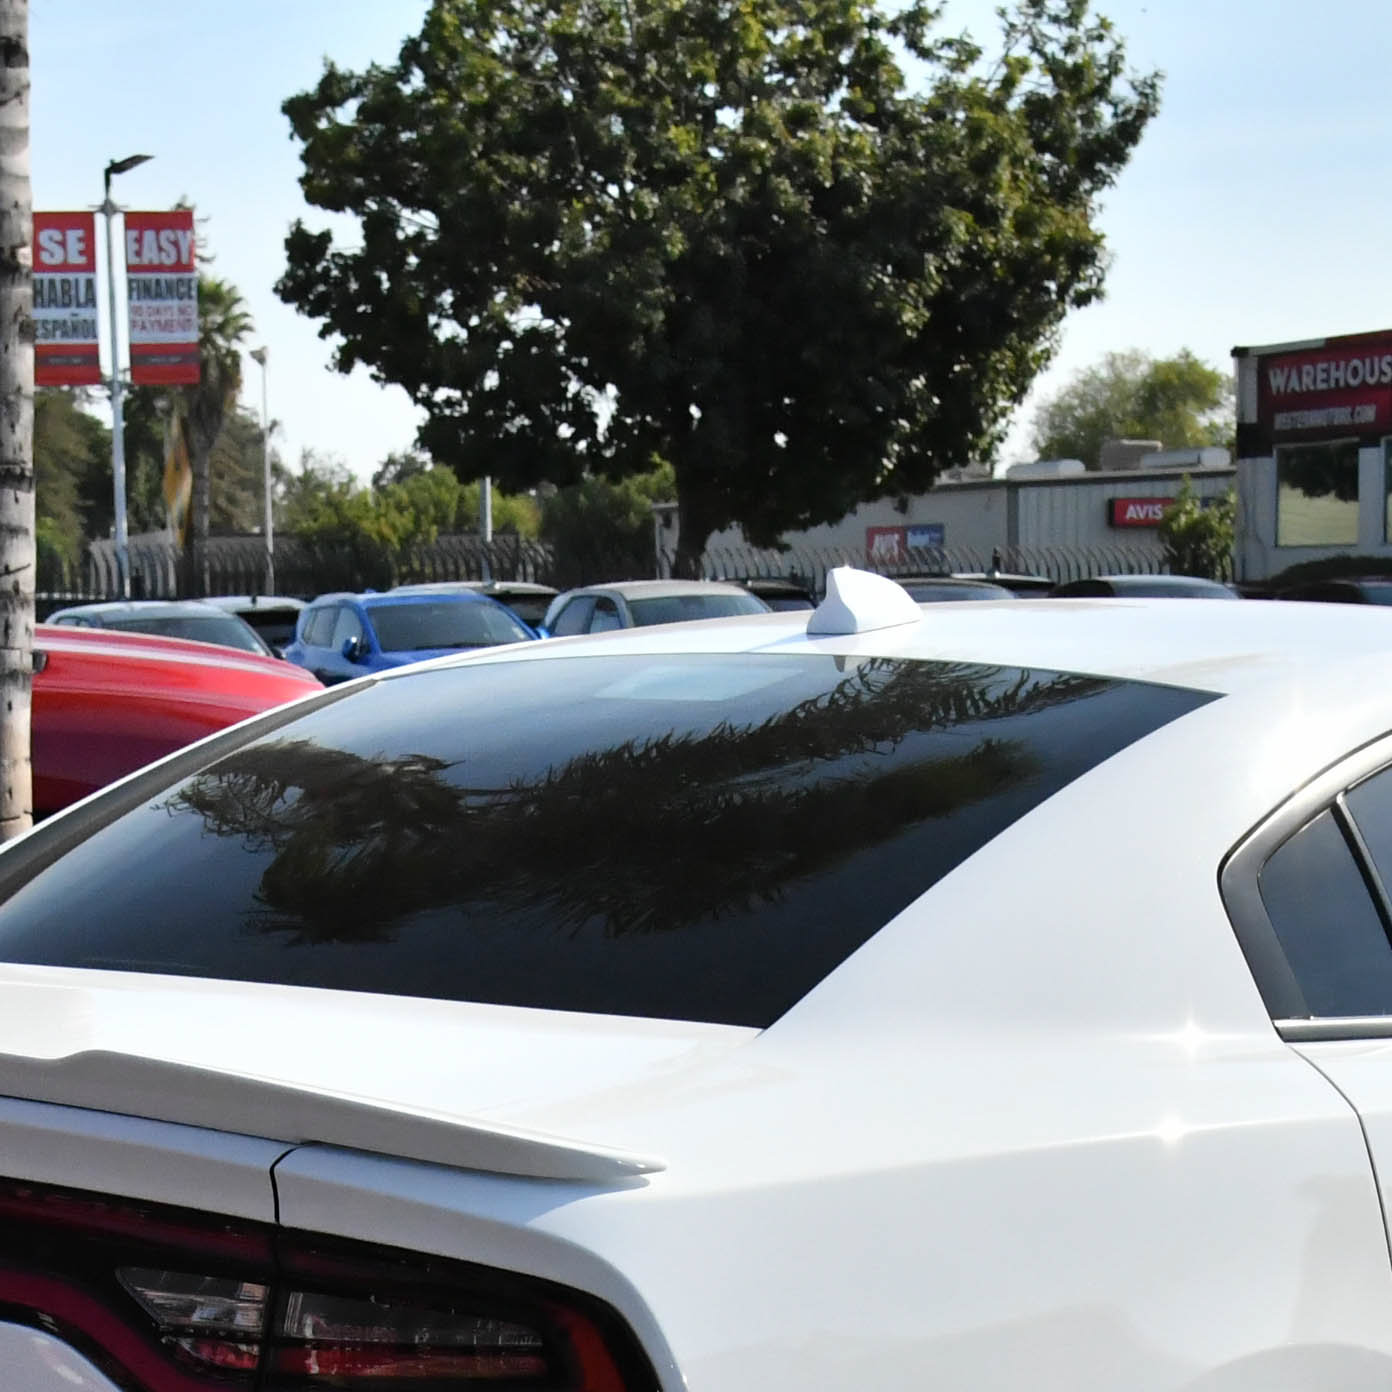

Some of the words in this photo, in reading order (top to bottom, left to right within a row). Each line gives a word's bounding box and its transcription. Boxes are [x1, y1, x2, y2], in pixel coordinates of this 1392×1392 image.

[38, 228, 87, 266] SE
[126, 229, 193, 266] EASY
[32, 278, 97, 308] HABLA
[128, 278, 194, 301] FINANCE
[1126, 504, 1164, 521] AVIS
